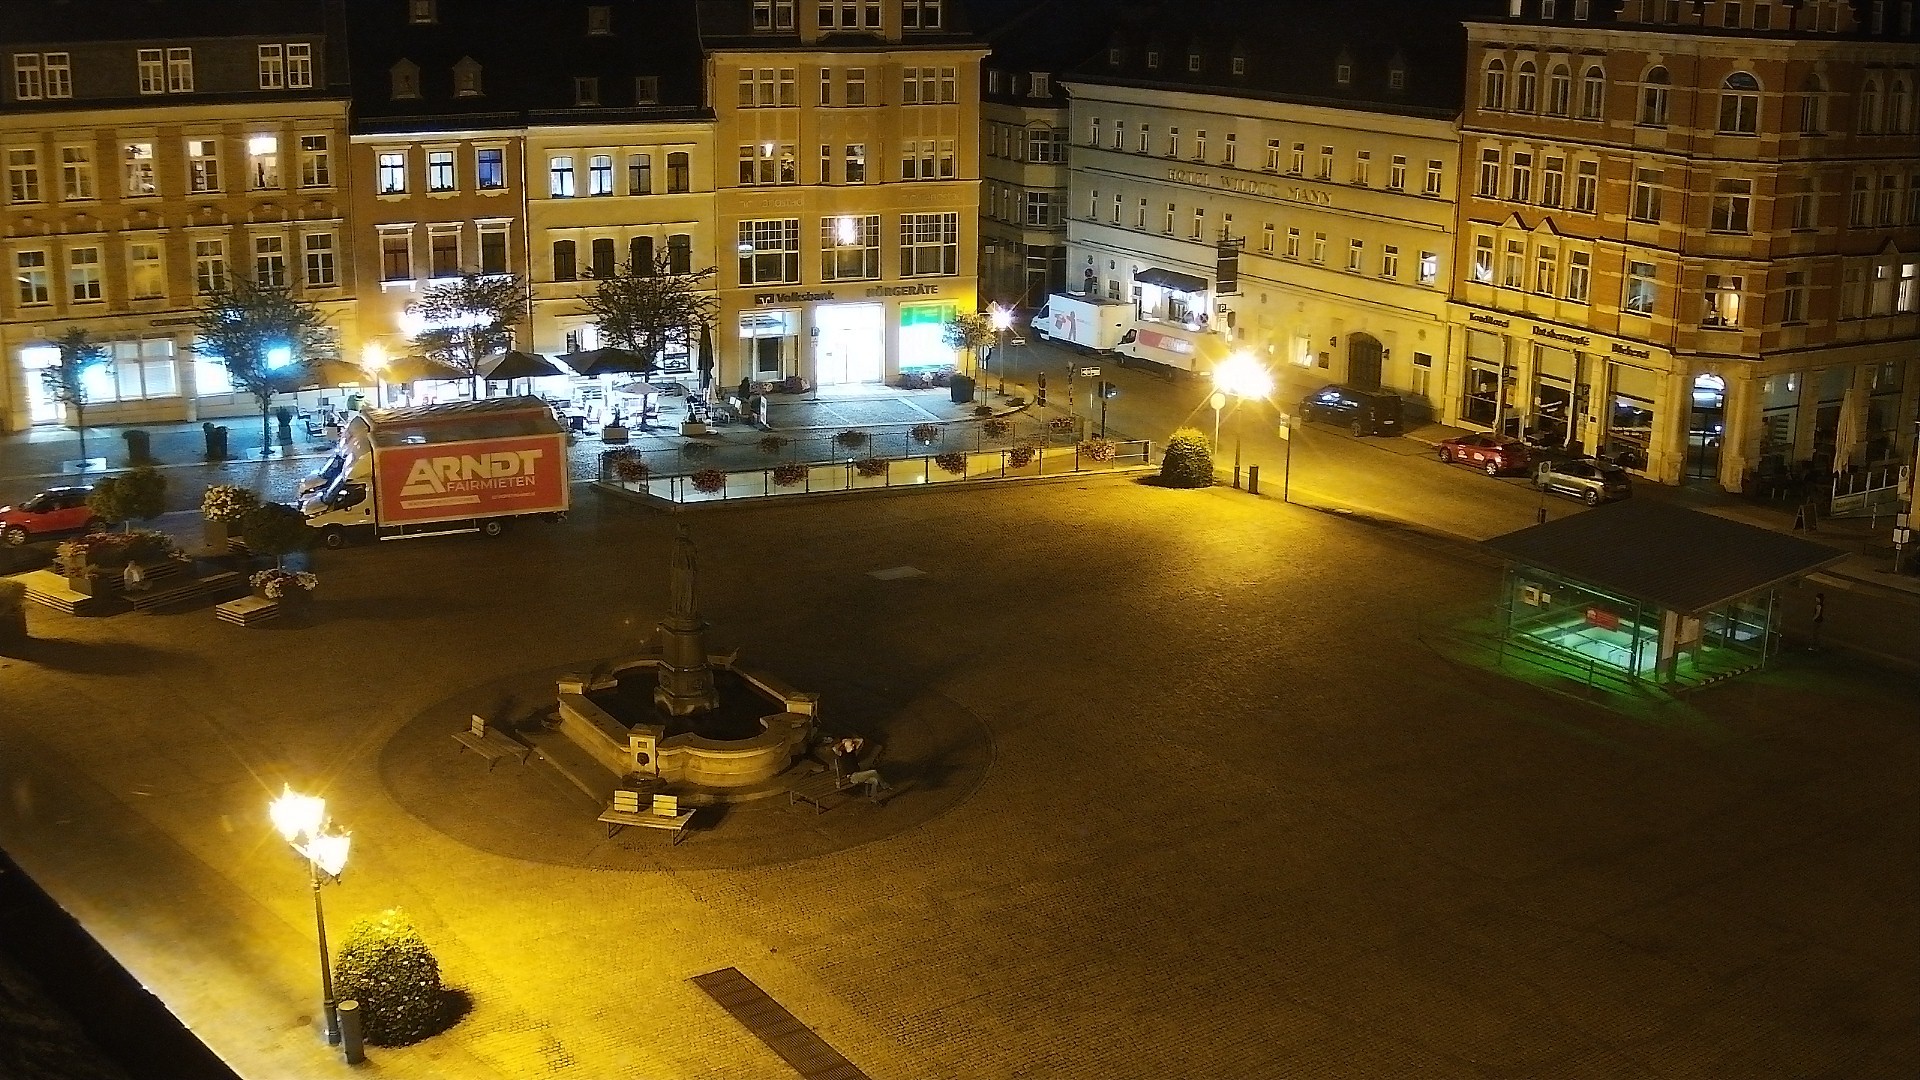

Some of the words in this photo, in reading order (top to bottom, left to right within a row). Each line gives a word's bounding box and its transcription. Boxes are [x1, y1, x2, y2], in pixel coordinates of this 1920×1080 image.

[1168, 168, 1211, 186] HOTEL
[1221, 175, 1280, 197] WILDER
[1288, 186, 1332, 206] MANN
[777, 290, 834, 303] Volksbank
[866, 284, 939, 297] HÖRGERÄTE
[1469, 312, 1510, 328] Konditorei
[400, 449, 543, 497] ARNDT
[447, 476, 536, 493] FAIRMIETEN
